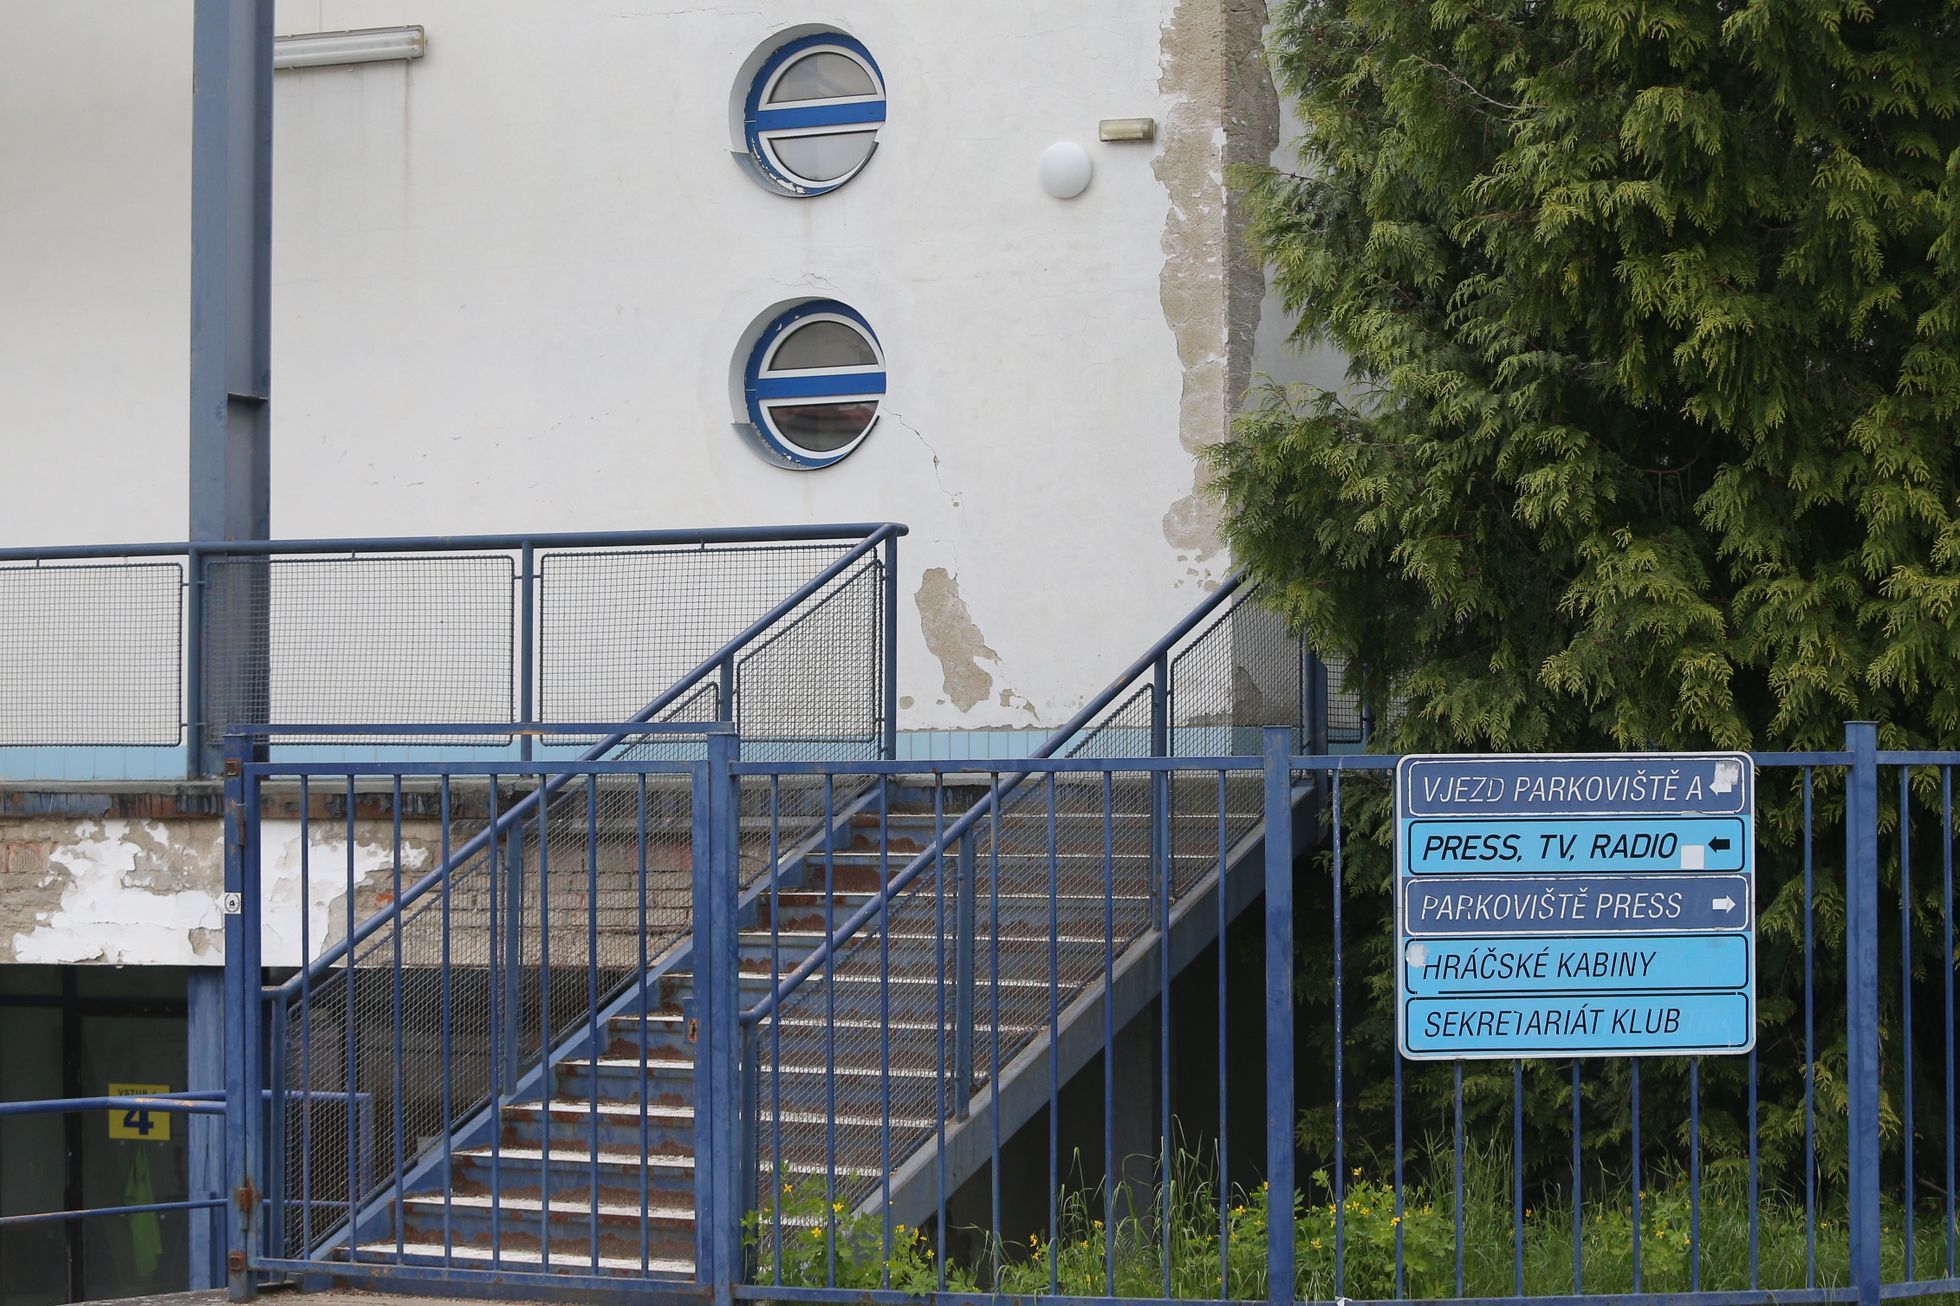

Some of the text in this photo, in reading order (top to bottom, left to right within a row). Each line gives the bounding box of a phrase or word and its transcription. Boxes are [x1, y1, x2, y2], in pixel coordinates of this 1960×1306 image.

[1423, 768, 1703, 803] VJEZD PARKOVIŠTĚ A
[1422, 832, 1678, 863] PRESS, TV, RADIO
[1420, 887, 1683, 921] PARKOVIŠTĚ PRESS
[1423, 946, 1657, 980] HRÁČSKÉ KABINY
[1424, 1003, 1681, 1038] SEKRETARIÁT KLUB
[123, 1108, 155, 1135] 4
